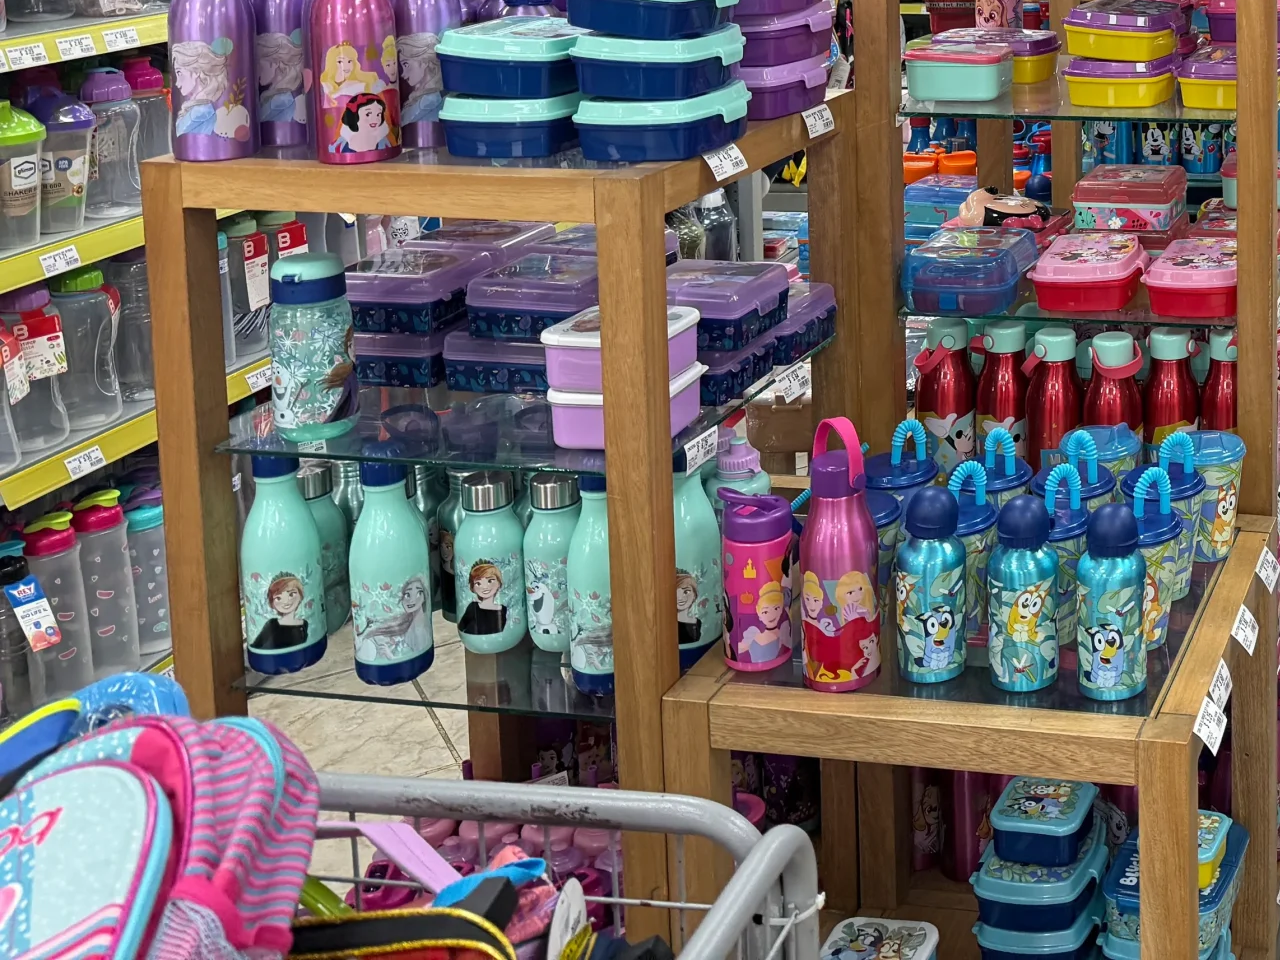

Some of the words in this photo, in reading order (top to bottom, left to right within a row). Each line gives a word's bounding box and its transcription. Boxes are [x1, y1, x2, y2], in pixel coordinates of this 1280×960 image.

[277, 231, 291, 248] B
[243, 240, 254, 257] B
[13, 324, 29, 340] B
[1, 345, 11, 363] B
